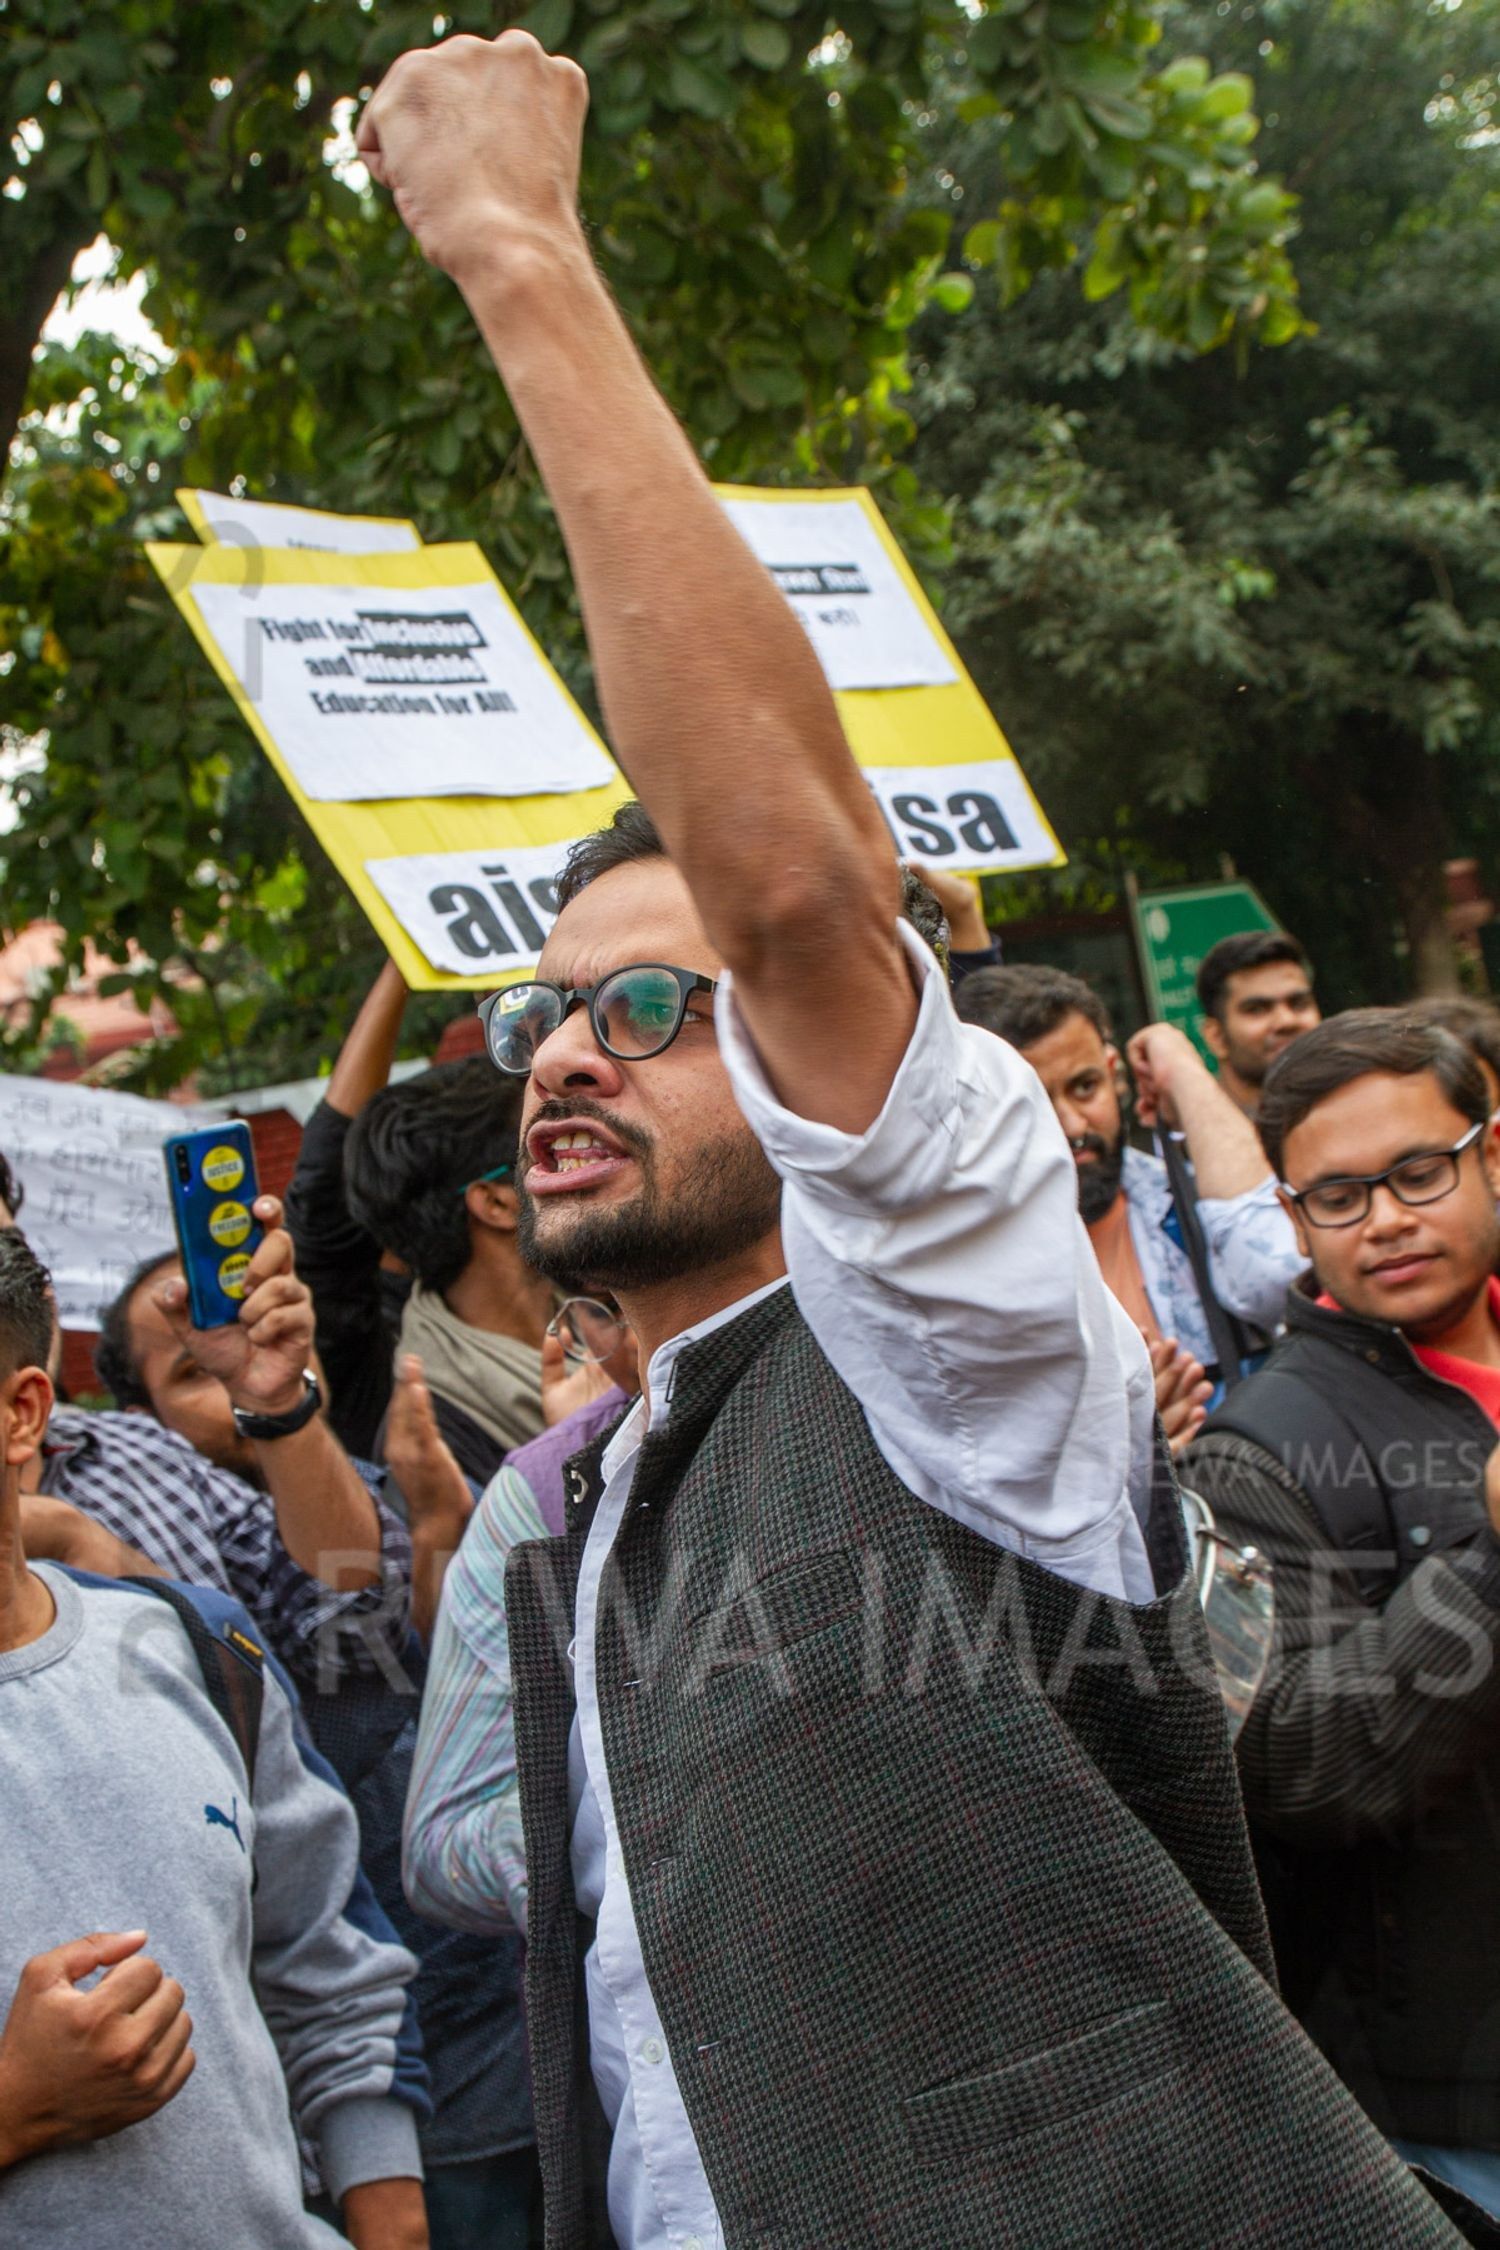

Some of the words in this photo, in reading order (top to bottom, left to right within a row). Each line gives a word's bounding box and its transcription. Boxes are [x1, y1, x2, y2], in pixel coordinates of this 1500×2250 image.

[258, 617, 327, 643] Fight
[326, 617, 363, 640] for
[359, 617, 482, 645] Inclusive
[303, 655, 354, 677] and
[352, 652, 486, 680] Affordable
[309, 691, 436, 715] Education
[434, 692, 472, 715] for
[474, 691, 518, 713] All!
[884, 788, 1021, 857] sa
